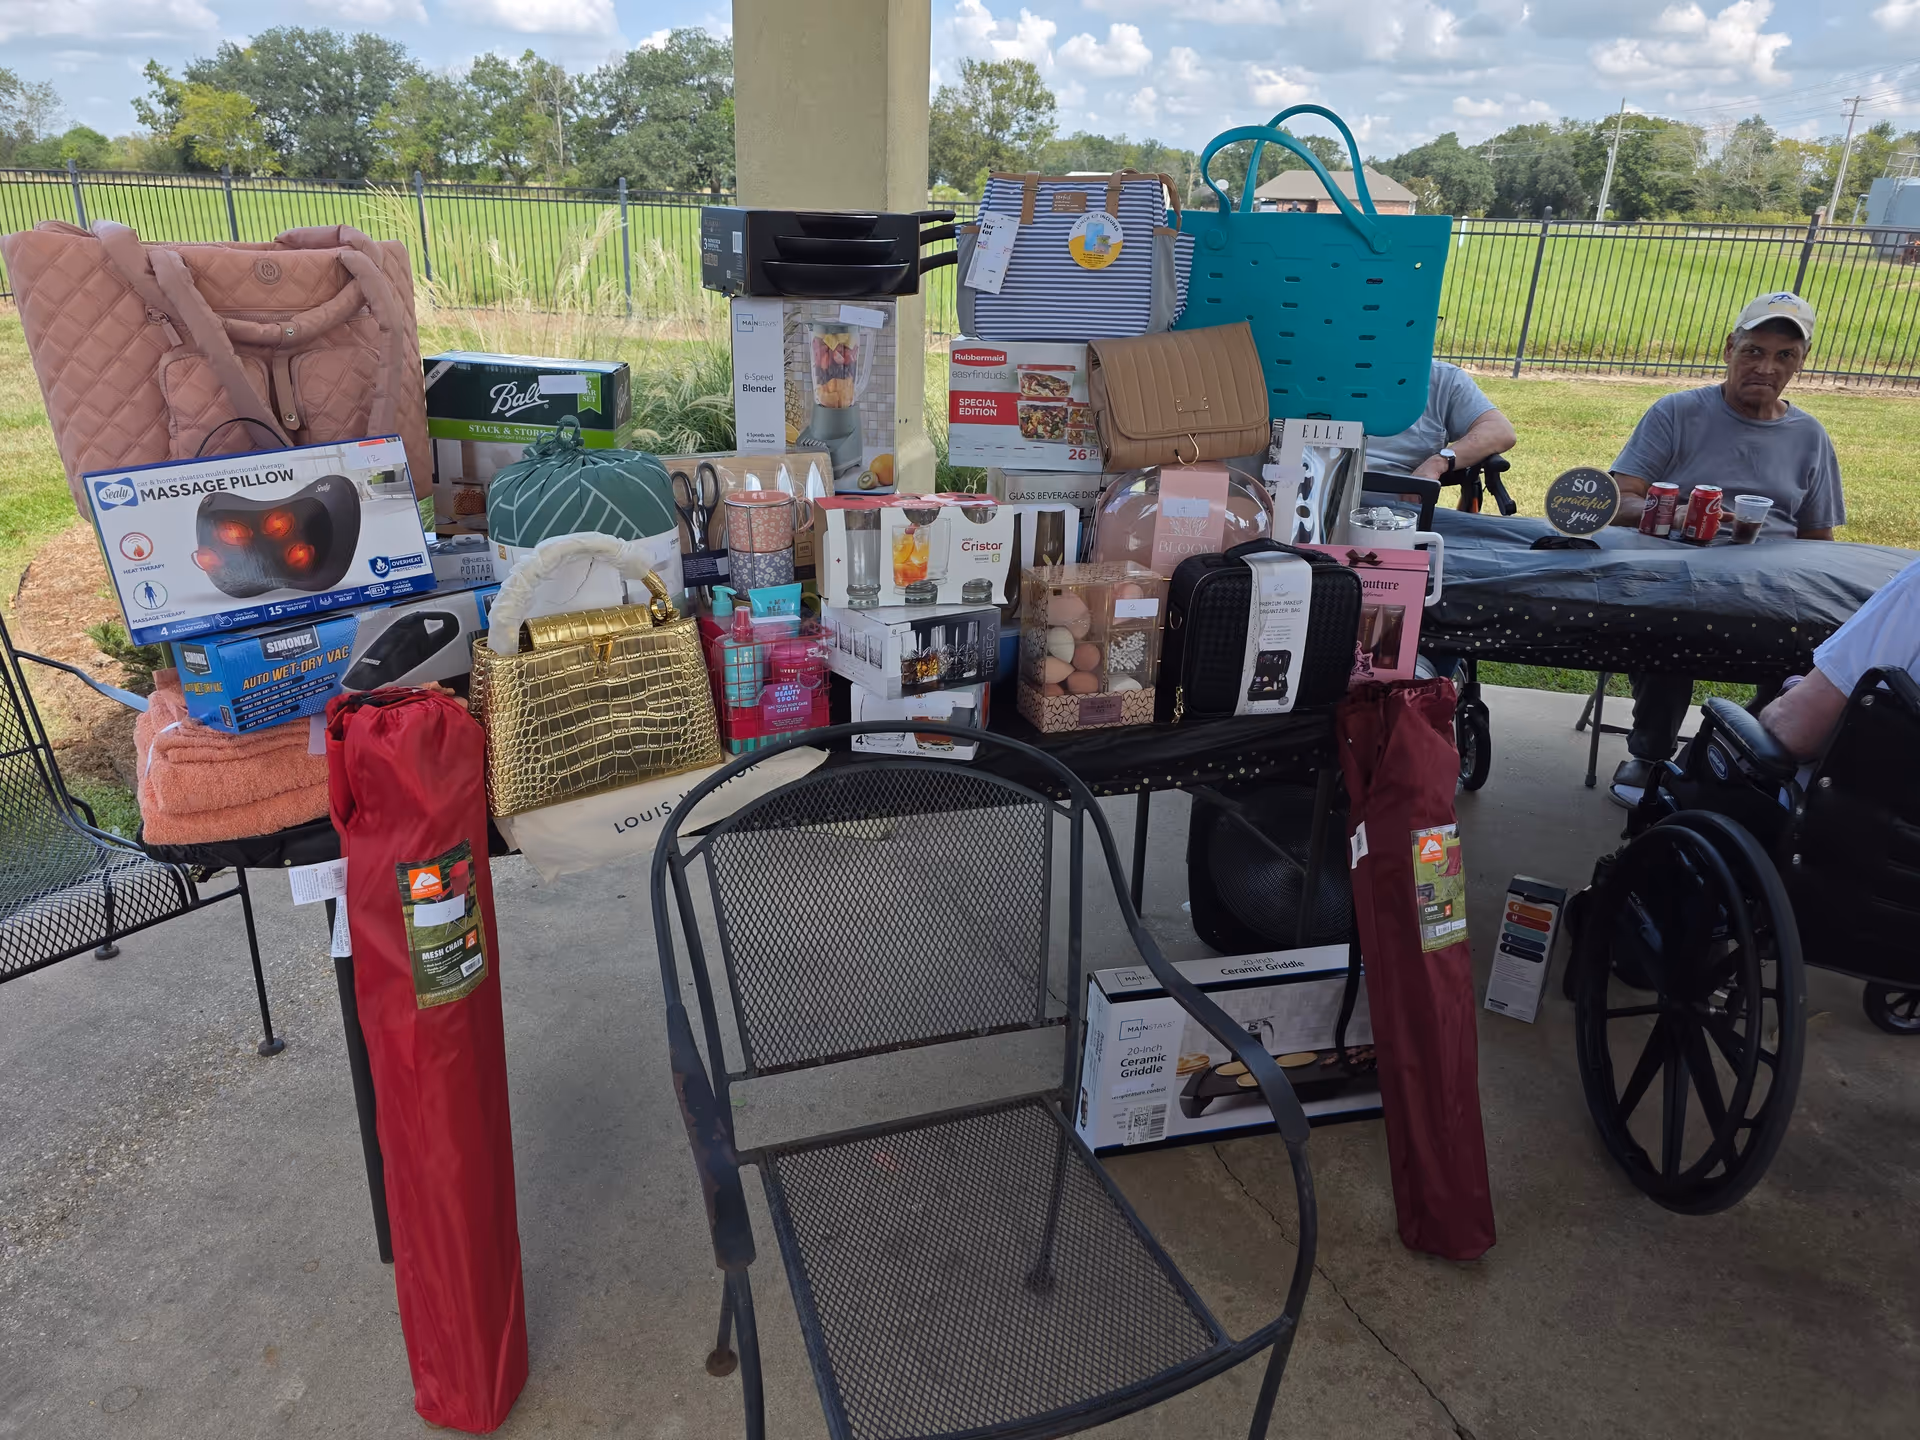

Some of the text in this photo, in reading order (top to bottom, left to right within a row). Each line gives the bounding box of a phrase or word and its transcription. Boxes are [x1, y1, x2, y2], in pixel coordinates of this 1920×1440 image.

[1076, 216, 1090, 230] LUNCH
[1100, 214, 1120, 232] INCLUDED
[704, 238, 708, 250] 3
[954, 354, 1005, 362] Rubbermaid
[430, 369, 440, 380] NEW
[744, 373, 774, 382] 6-Speed
[586, 380, 592, 389] 3
[742, 384, 776, 393] Blender
[490, 381, 546, 415] Ball
[959, 398, 997, 407] SPECIAL
[959, 407, 997, 416] EDITION
[468, 424, 501, 434] STACK
[1302, 424, 1344, 440] ELLE
[1068, 449, 1087, 460] 26
[156, 476, 177, 484] home
[179, 472, 204, 482] shiatsu
[205, 465, 259, 478] multifunctional
[260, 462, 285, 472] therapy
[140, 468, 294, 502] MASSAGE PILLOW
[1572, 478, 1597, 493] SO
[102, 486, 128, 500] Sealy
[1009, 492, 1035, 500] GLASS
[1038, 491, 1080, 499] BEVERAGE
[1551, 495, 1611, 510] grateful
[1566, 511, 1599, 524] you
[962, 541, 1003, 551] Cristar
[1159, 541, 1215, 554] BLOOM
[139, 563, 165, 572] THERAPY
[392, 557, 421, 566] OVERHEAT
[1361, 577, 1399, 590] outure
[268, 606, 282, 615] 15
[133, 616, 160, 624] MASSAGE
[161, 610, 186, 619] THERAPY
[160, 627, 168, 636] 4
[266, 633, 312, 653] SIMONIZ
[985, 622, 996, 675] TRIBECA
[184, 651, 207, 665] SIMONIZ
[242, 645, 349, 691] AUTO WET-DRY VAC
[855, 734, 864, 745] 4
[614, 802, 672, 834] LOUIS
[422, 938, 464, 960] MESH CHAIR
[1241, 956, 1275, 966] 20-Inch
[1221, 960, 1305, 976] Ceramic Griddle
[1127, 1022, 1172, 1032] MAINSTAYS
[1127, 1044, 1163, 1056] 20-Inch
[1121, 1053, 1167, 1067] Ceramic
[1121, 1064, 1163, 1078] Griddle
[1146, 1086, 1166, 1094] control
